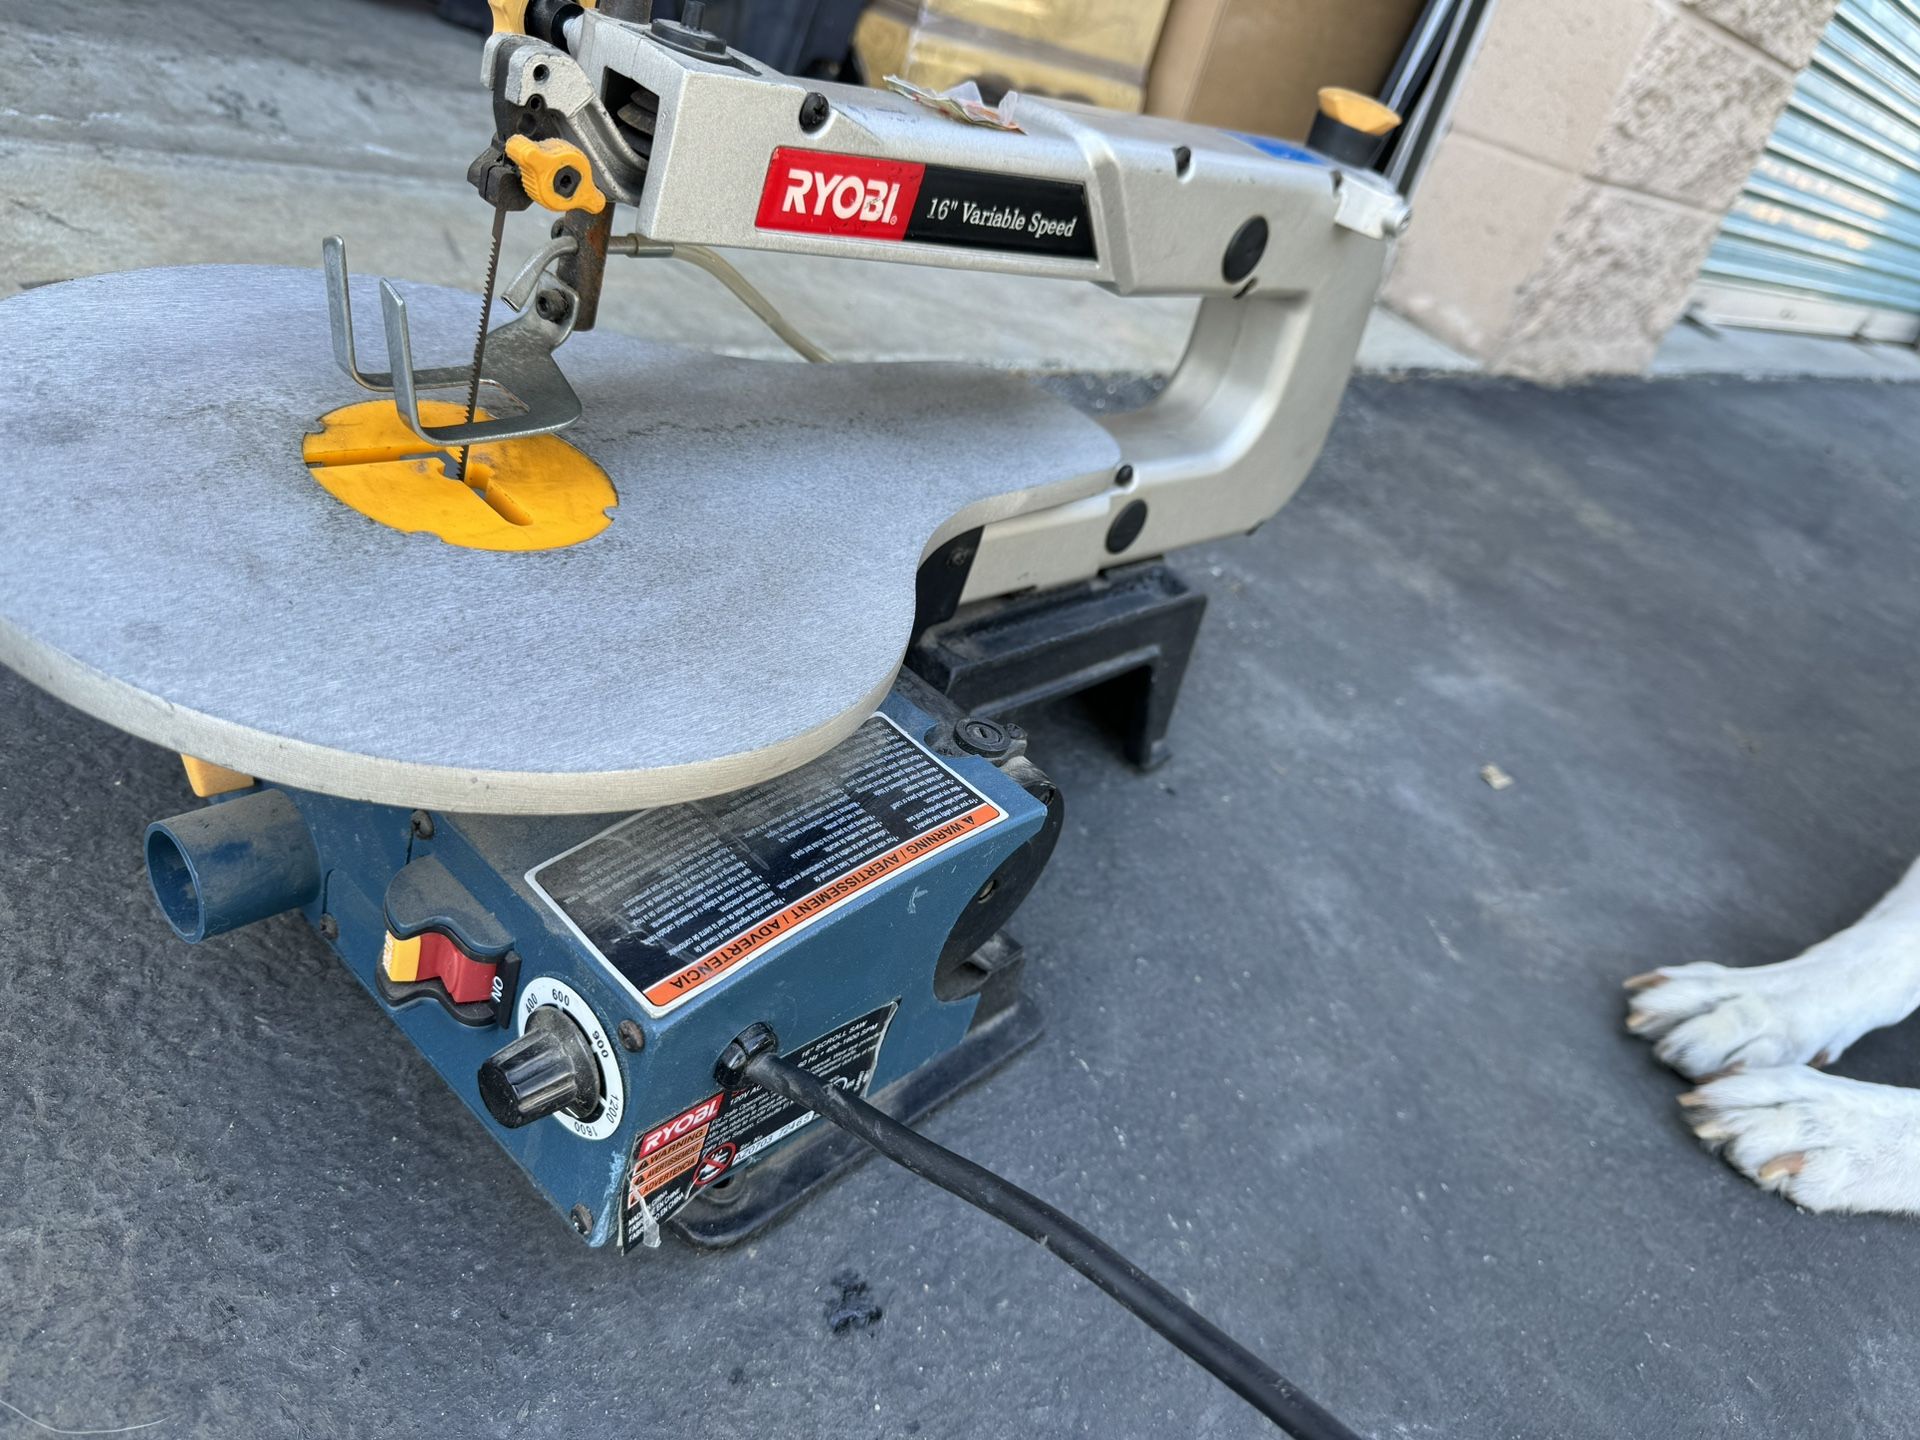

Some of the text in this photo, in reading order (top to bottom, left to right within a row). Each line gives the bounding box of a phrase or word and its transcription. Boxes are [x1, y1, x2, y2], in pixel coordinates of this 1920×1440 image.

[781, 168, 1077, 239] RYOBI 16" Variable Speed
[906, 823, 963, 854] WARNING
[790, 855, 899, 918] AVERTISSEMENT
[671, 920, 781, 988] ADVERTENCIA
[491, 975, 504, 1002] ON
[526, 993, 538, 1014] 400
[552, 988, 570, 1007] 600
[592, 1030, 609, 1059] 900
[815, 1031, 846, 1050] SCROLL
[849, 1021, 867, 1033] SAW
[606, 1094, 619, 1123] 1200
[574, 1121, 598, 1137] 1600
[645, 1102, 715, 1151] RYOBI
[647, 1143, 699, 1177] AVERTISSEMENT
[651, 1129, 703, 1162] WARNING
[644, 1158, 695, 1192] ADVERTENCIA
